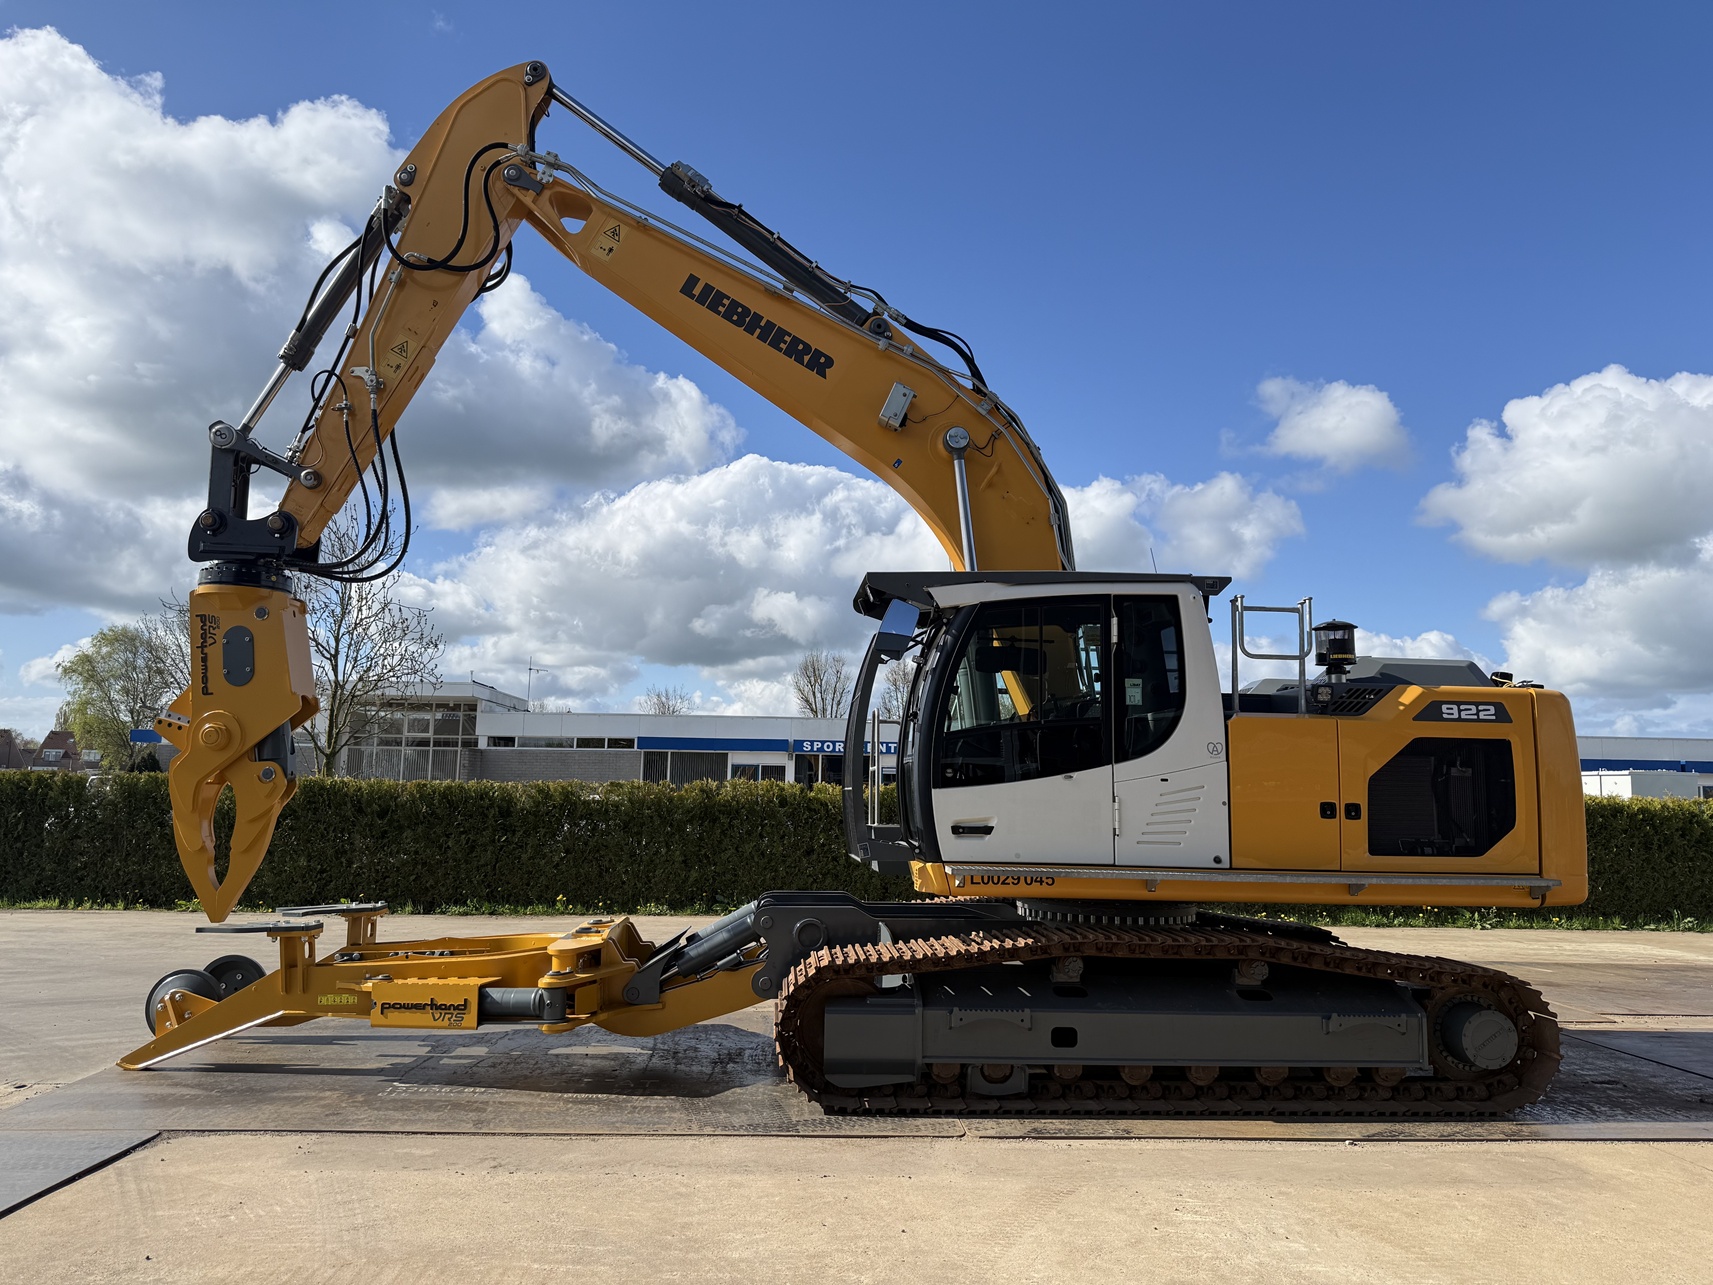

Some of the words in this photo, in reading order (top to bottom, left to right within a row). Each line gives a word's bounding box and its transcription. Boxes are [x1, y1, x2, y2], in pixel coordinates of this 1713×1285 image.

[679, 273, 835, 380] LIEBHERR
[207, 613, 217, 647] VRS
[195, 613, 214, 696] powerhand
[1441, 704, 1496, 720] 922
[380, 997, 469, 1015] powerhand
[430, 1011, 467, 1022] VRS
